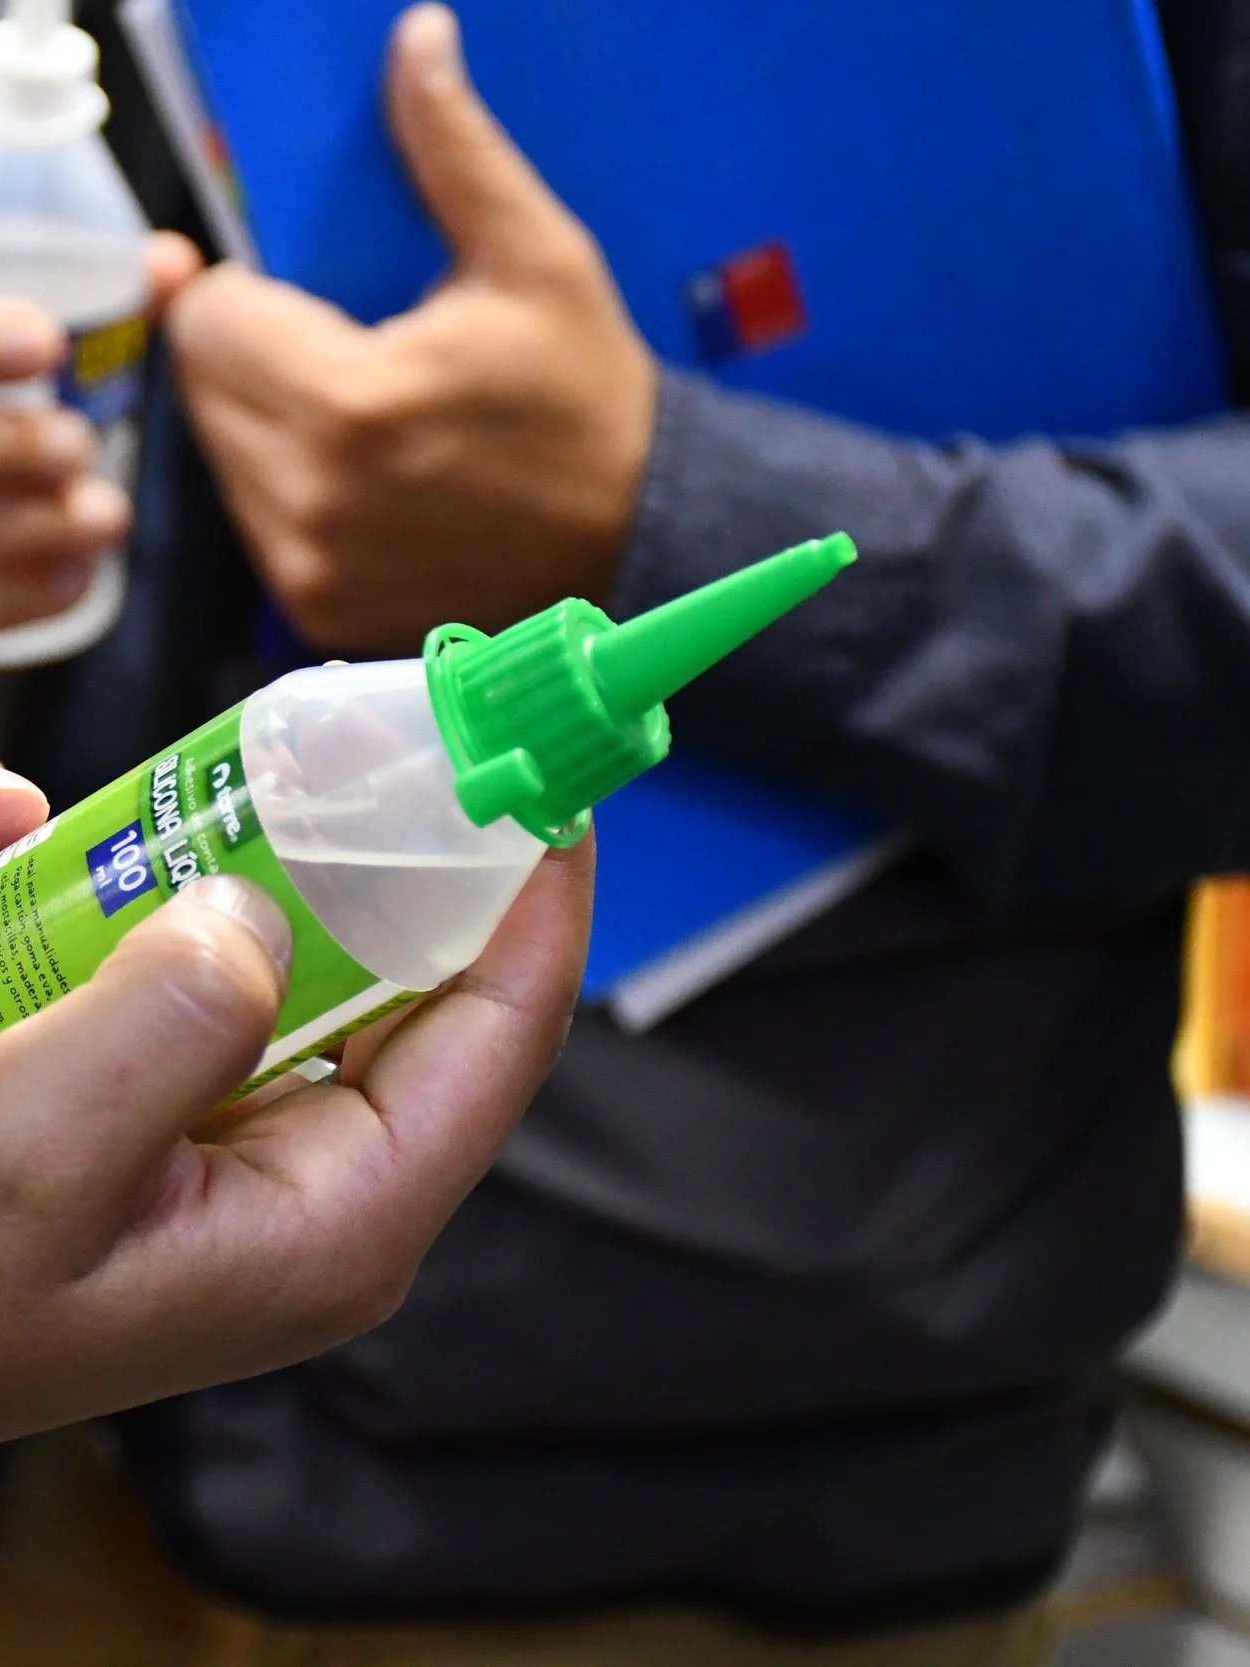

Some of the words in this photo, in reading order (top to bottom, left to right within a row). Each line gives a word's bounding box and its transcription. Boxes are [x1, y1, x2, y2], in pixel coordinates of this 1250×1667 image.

[153, 755, 182, 840] SILICONA
[95, 865, 112, 888] ml
[111, 830, 147, 891] 100
[197, 833, 219, 874] conta
[11, 866, 23, 891] Pega
[20, 935, 40, 971] goma
[26, 881, 37, 906] para
[32, 909, 71, 995] manualidades
[2, 976, 13, 985] y
[10, 987, 30, 1019] otros
